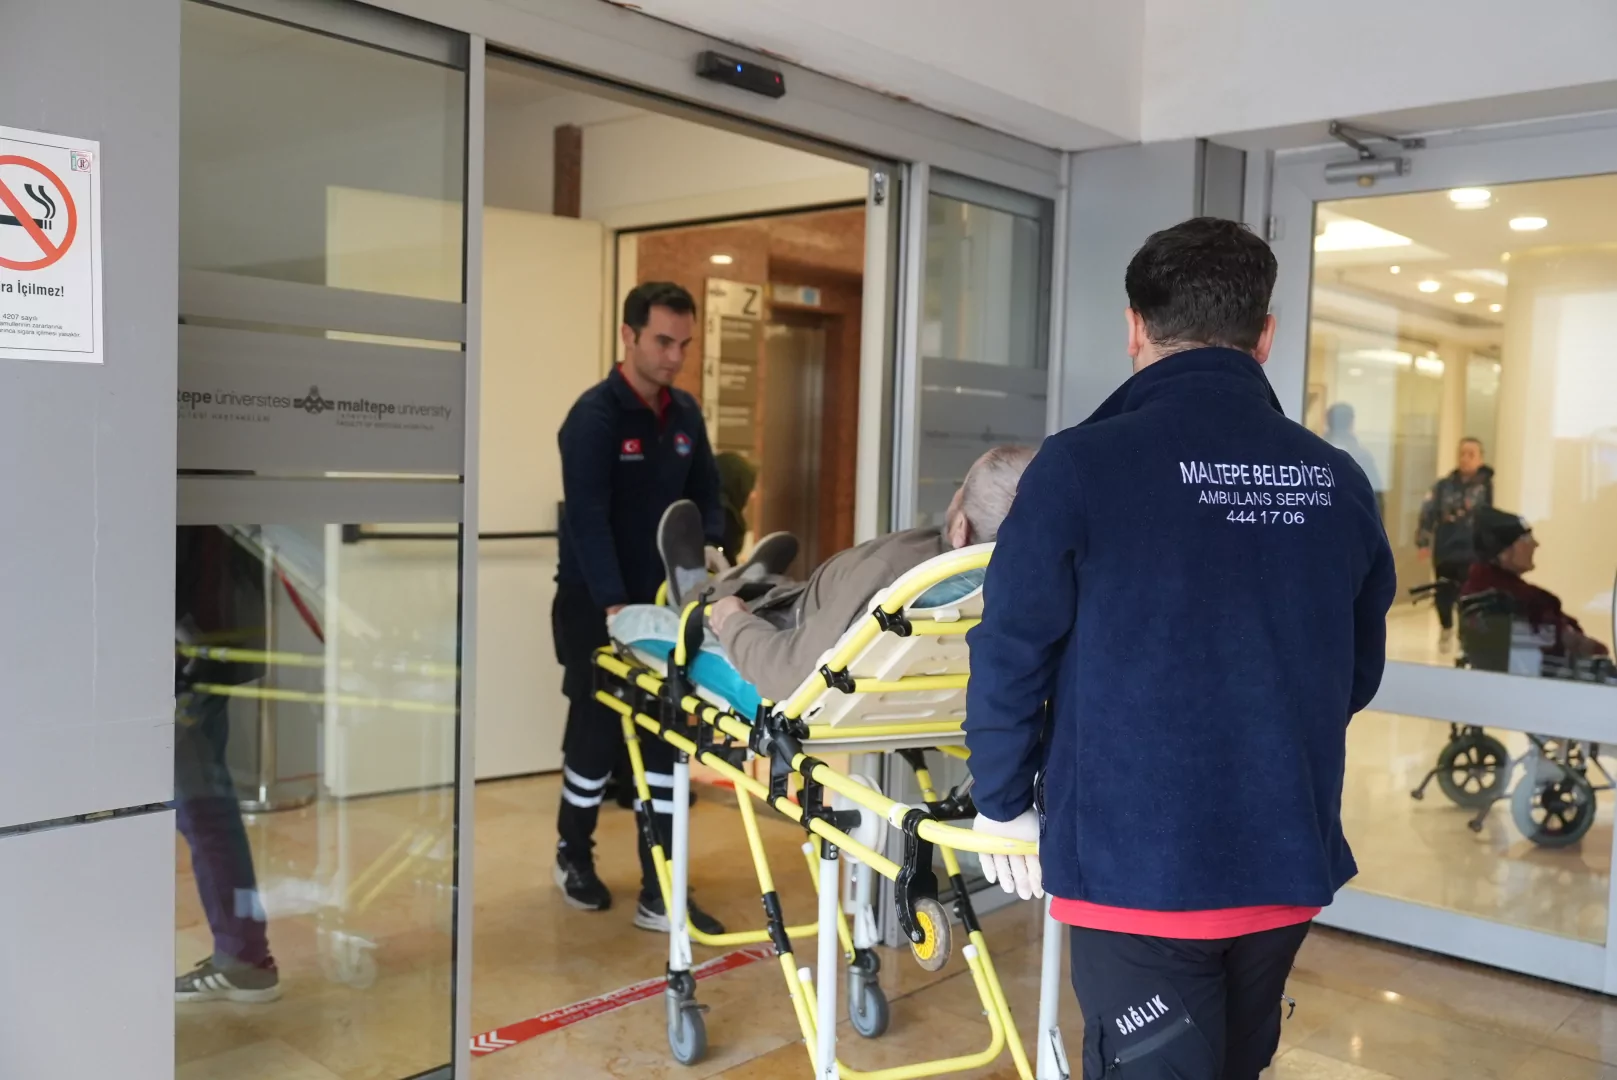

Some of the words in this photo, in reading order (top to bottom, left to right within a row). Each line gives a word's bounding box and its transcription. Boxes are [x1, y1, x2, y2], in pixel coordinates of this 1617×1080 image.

[17, 279, 64, 297] İçilmez!
[337, 399, 396, 420] maltepe
[397, 400, 452, 421] university
[1179, 461, 1251, 485] MALTEPE
[1252, 460, 1336, 488] BELEDİYESİ
[1198, 490, 1272, 506] AMBULANS
[1275, 490, 1332, 507] SERVİSİ
[1226, 510, 1257, 524] 444
[1115, 994, 1170, 1035] SAĞLIK
